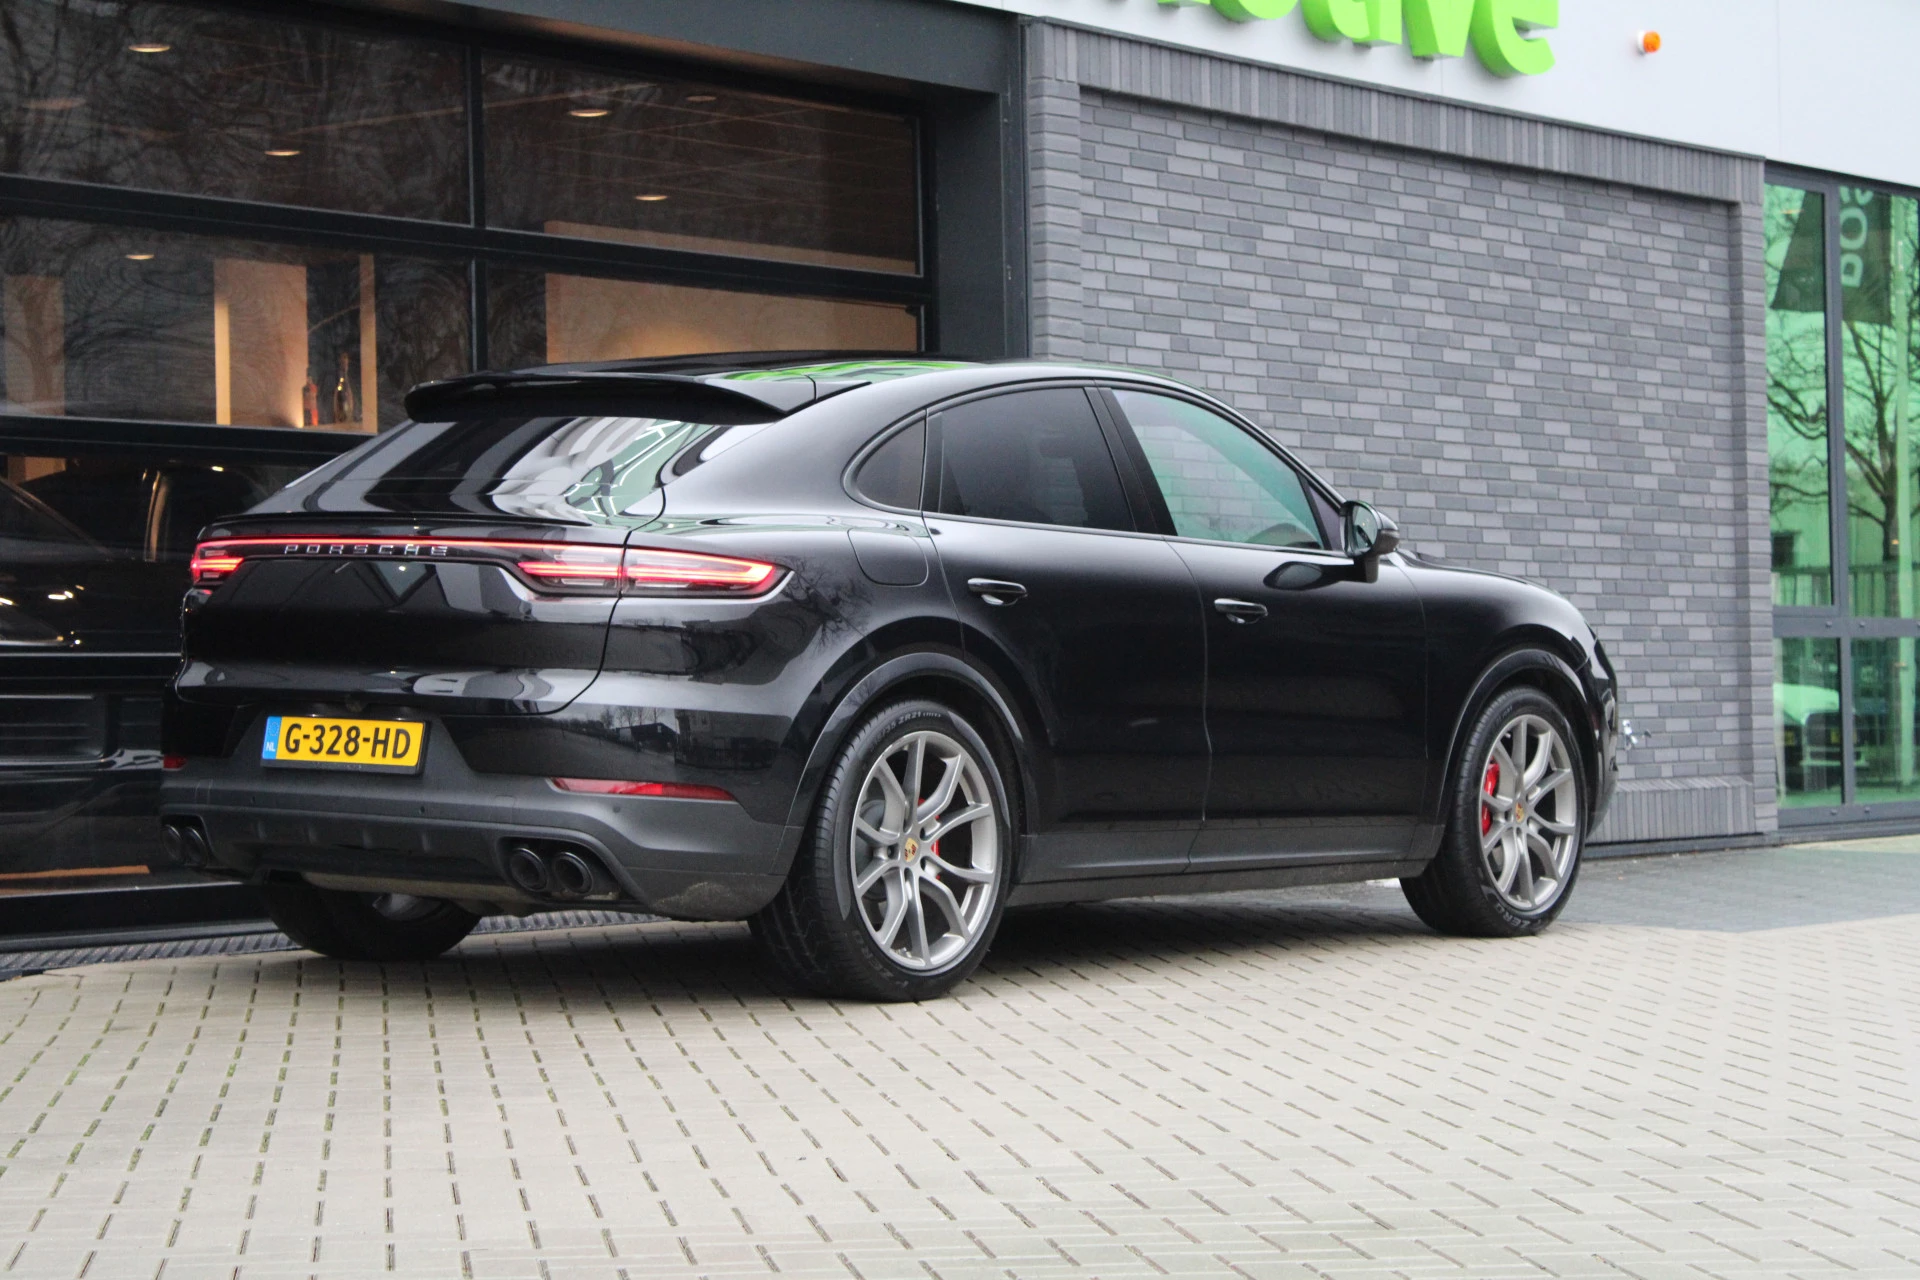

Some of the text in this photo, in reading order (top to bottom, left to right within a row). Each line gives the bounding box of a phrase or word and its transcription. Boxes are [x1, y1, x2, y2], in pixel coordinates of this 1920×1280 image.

[284, 544, 448, 557] PORSCHE
[265, 741, 276, 752] NL
[285, 723, 411, 760] G-328-HD
